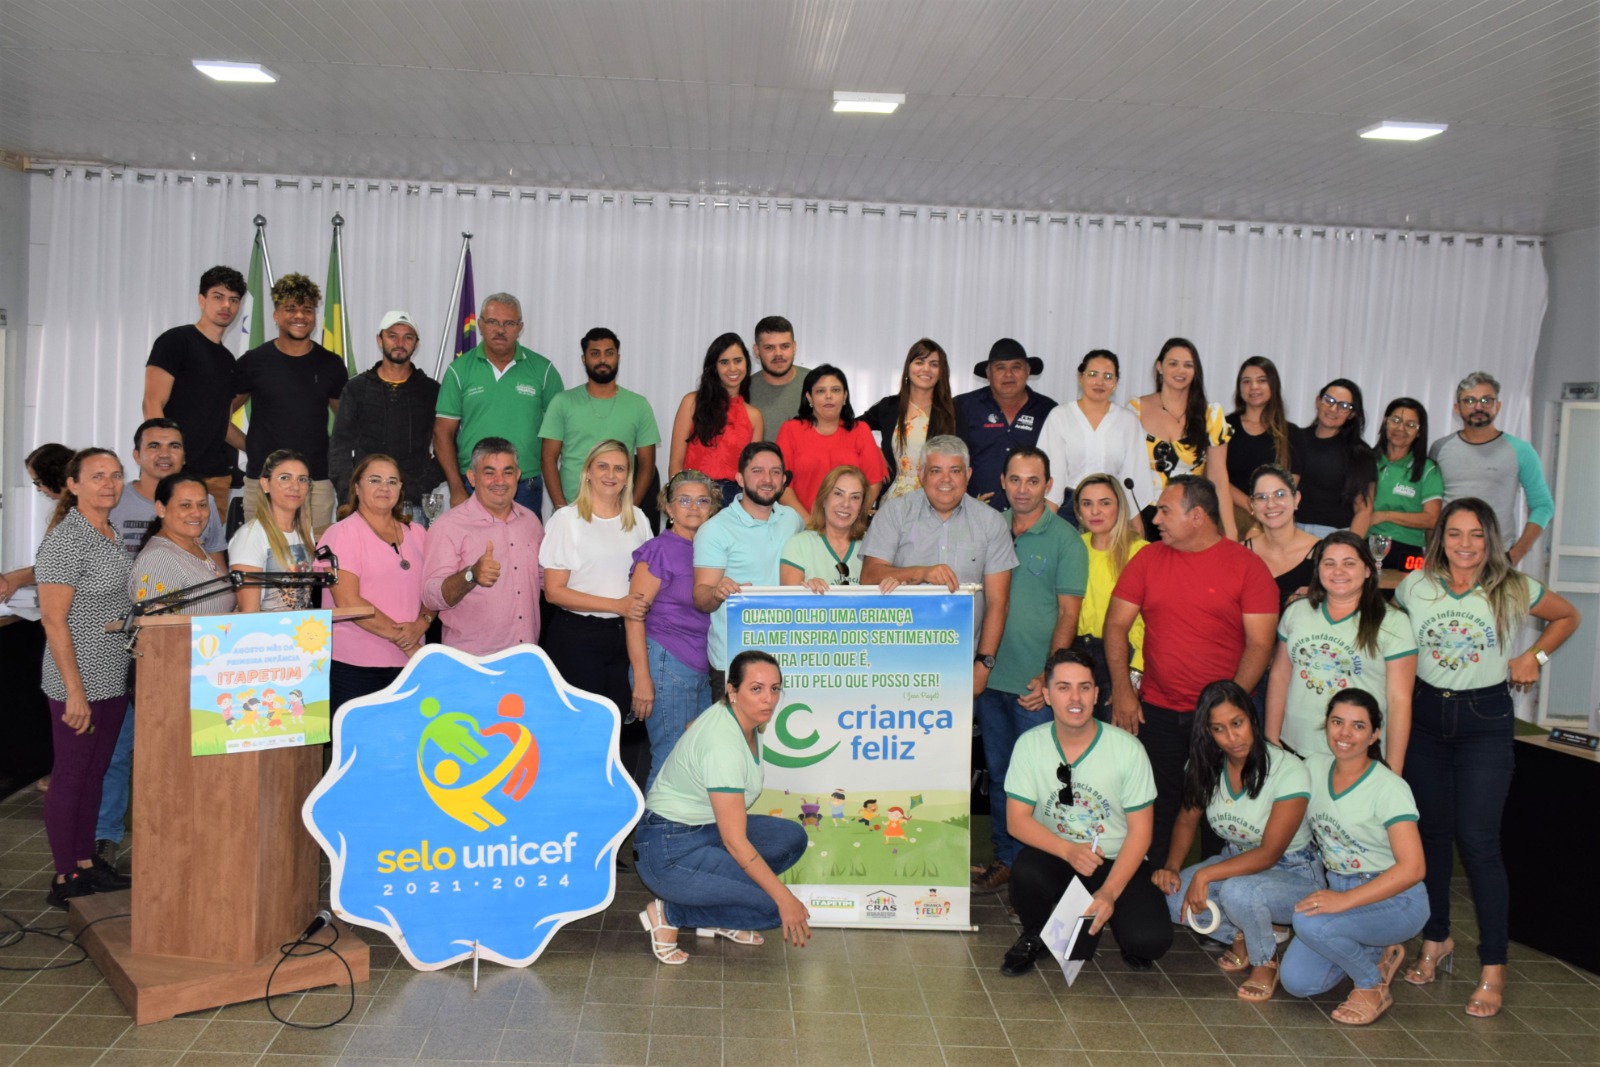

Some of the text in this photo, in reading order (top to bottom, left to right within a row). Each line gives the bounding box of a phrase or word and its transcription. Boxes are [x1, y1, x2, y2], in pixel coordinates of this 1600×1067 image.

[742, 608, 913, 626] QUANDO OLHO UMA CRIANÇA
[742, 630, 959, 646] ELA ME INSPIRA DOIS SENTIMENTOS:
[1483, 626, 1495, 648] SUAS
[800, 653, 830, 667] PELO
[833, 653, 856, 667] QUE
[860, 651, 870, 668] É,
[1351, 655, 1362, 675] SUAS
[218, 667, 302, 686] ITAPETIM
[783, 673, 940, 689] EITO PELO QUE POSSO SER!
[837, 704, 953, 734] criança
[850, 735, 916, 761] feliz
[377, 831, 579, 874] selo unicef
[922, 907, 943, 915] FELIZ
